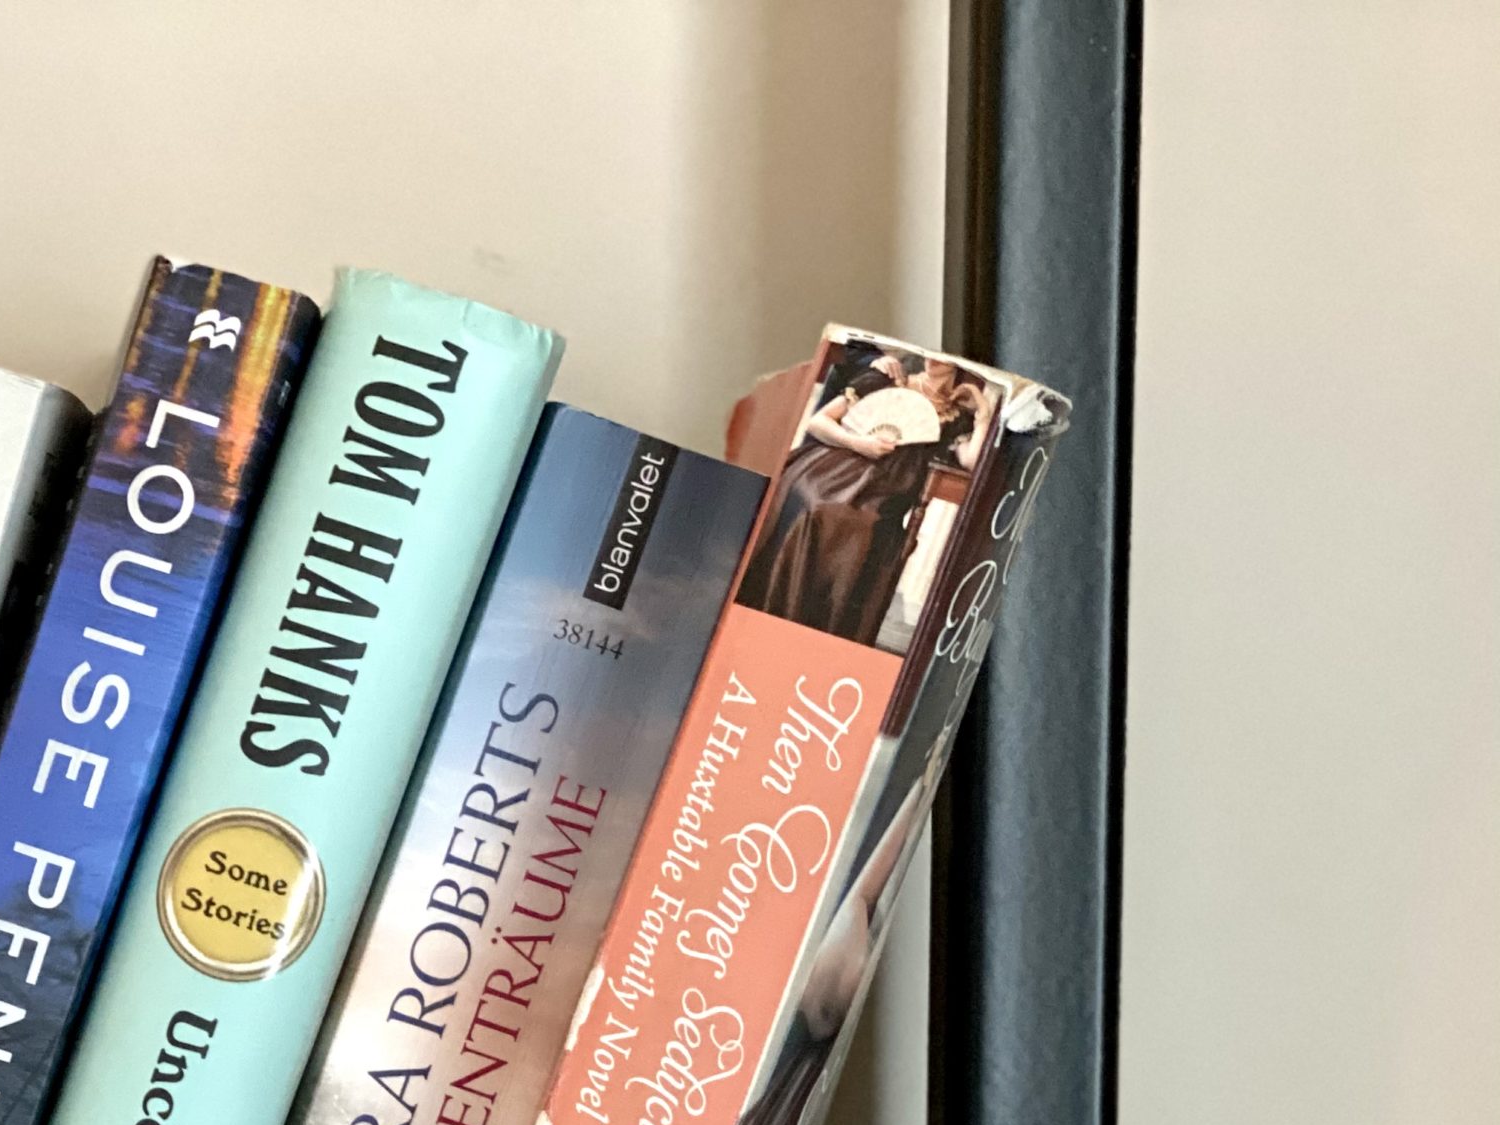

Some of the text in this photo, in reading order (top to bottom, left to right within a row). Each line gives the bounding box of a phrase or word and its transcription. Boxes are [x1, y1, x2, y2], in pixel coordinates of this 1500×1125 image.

[240, 335, 469, 777] TOM HANKS
[594, 452, 665, 594] blanvalet
[32, 399, 220, 809] LOUISE
[552, 619, 625, 661] 38144
[762, 675, 863, 797] Then
[181, 888, 286, 940] Stories
[204, 851, 288, 896] Some
[387, 681, 559, 1038] ROBERTS
[575, 671, 757, 1125] A Huxtable Family Novel
[677, 804, 832, 980] Comes
